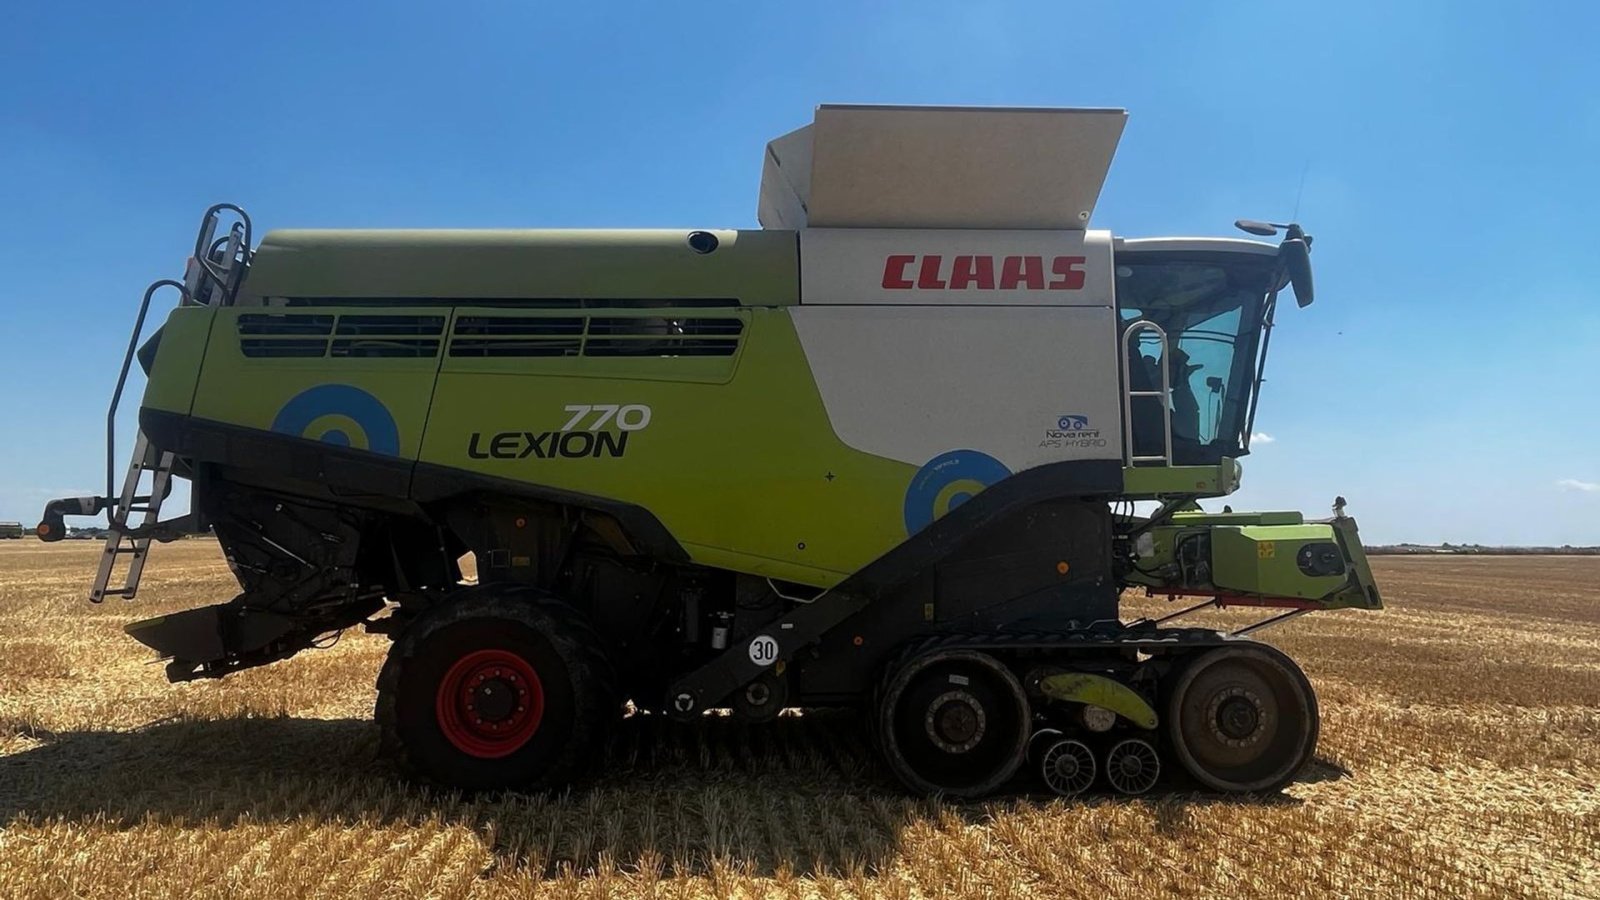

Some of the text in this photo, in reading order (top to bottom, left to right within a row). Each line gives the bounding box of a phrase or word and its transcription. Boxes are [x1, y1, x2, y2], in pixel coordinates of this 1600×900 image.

[882, 255, 1086, 290] CLAAS
[561, 404, 652, 431] 770
[468, 431, 629, 459] LEXION
[1039, 439, 1107, 448] APS HYBRID
[1046, 430, 1100, 438] Nova rent
[753, 641, 774, 660] 30
